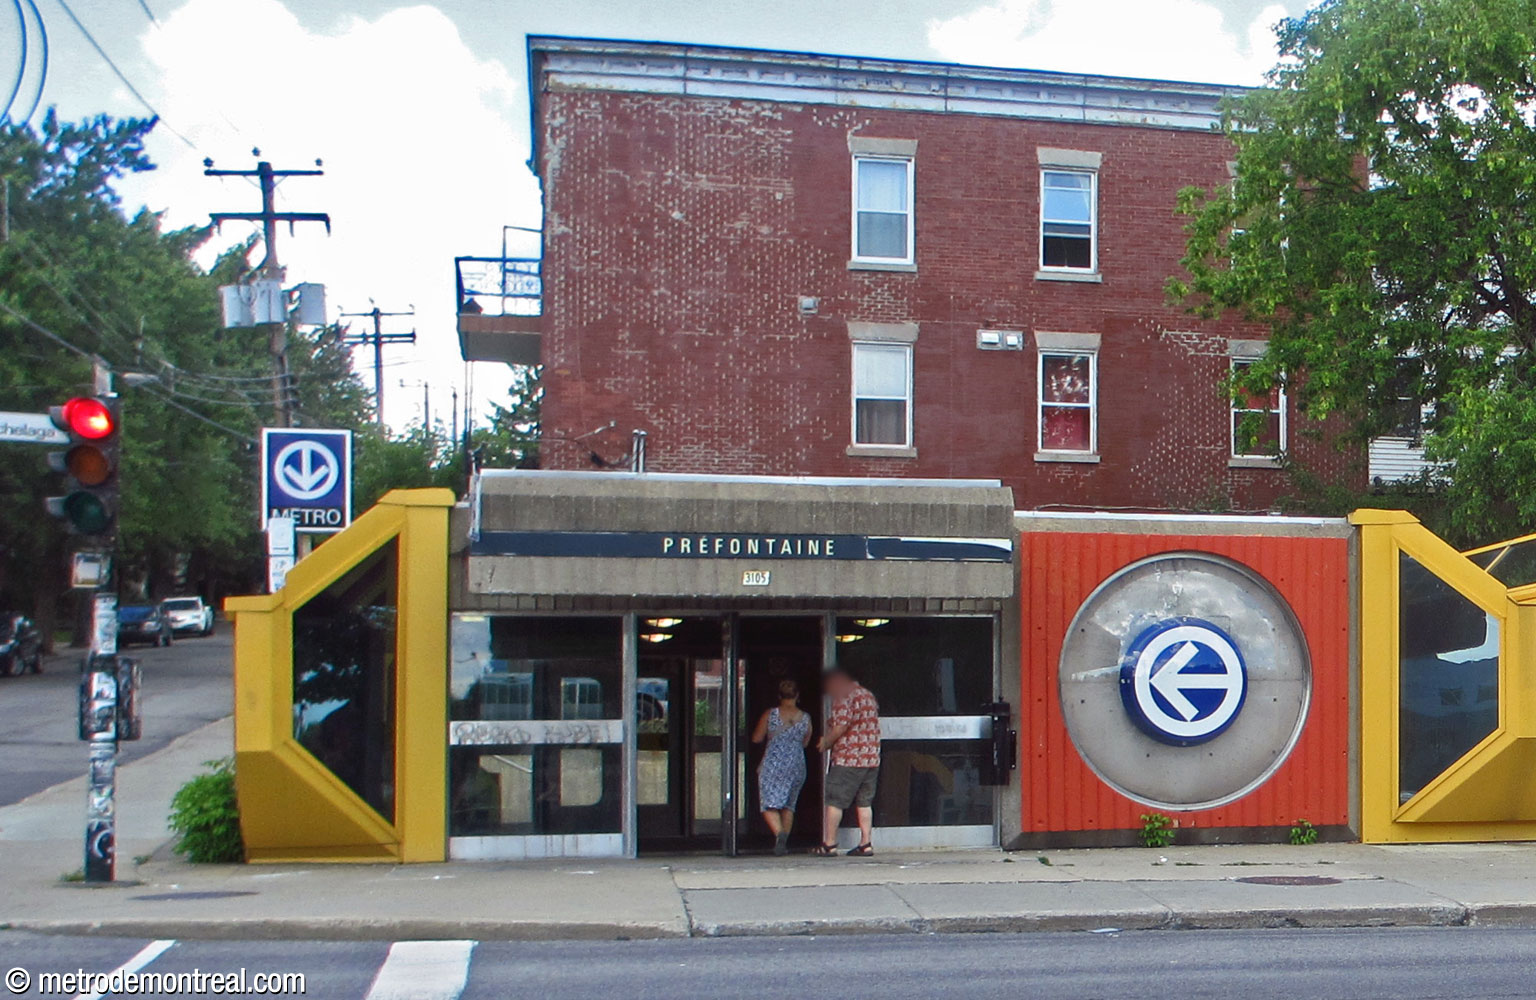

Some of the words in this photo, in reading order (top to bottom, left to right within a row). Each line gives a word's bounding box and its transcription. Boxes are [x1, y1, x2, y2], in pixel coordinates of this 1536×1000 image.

[272, 508, 342, 525] METRO
[663, 536, 835, 556] PRÉFONTAINE
[745, 572, 767, 584] 3105
